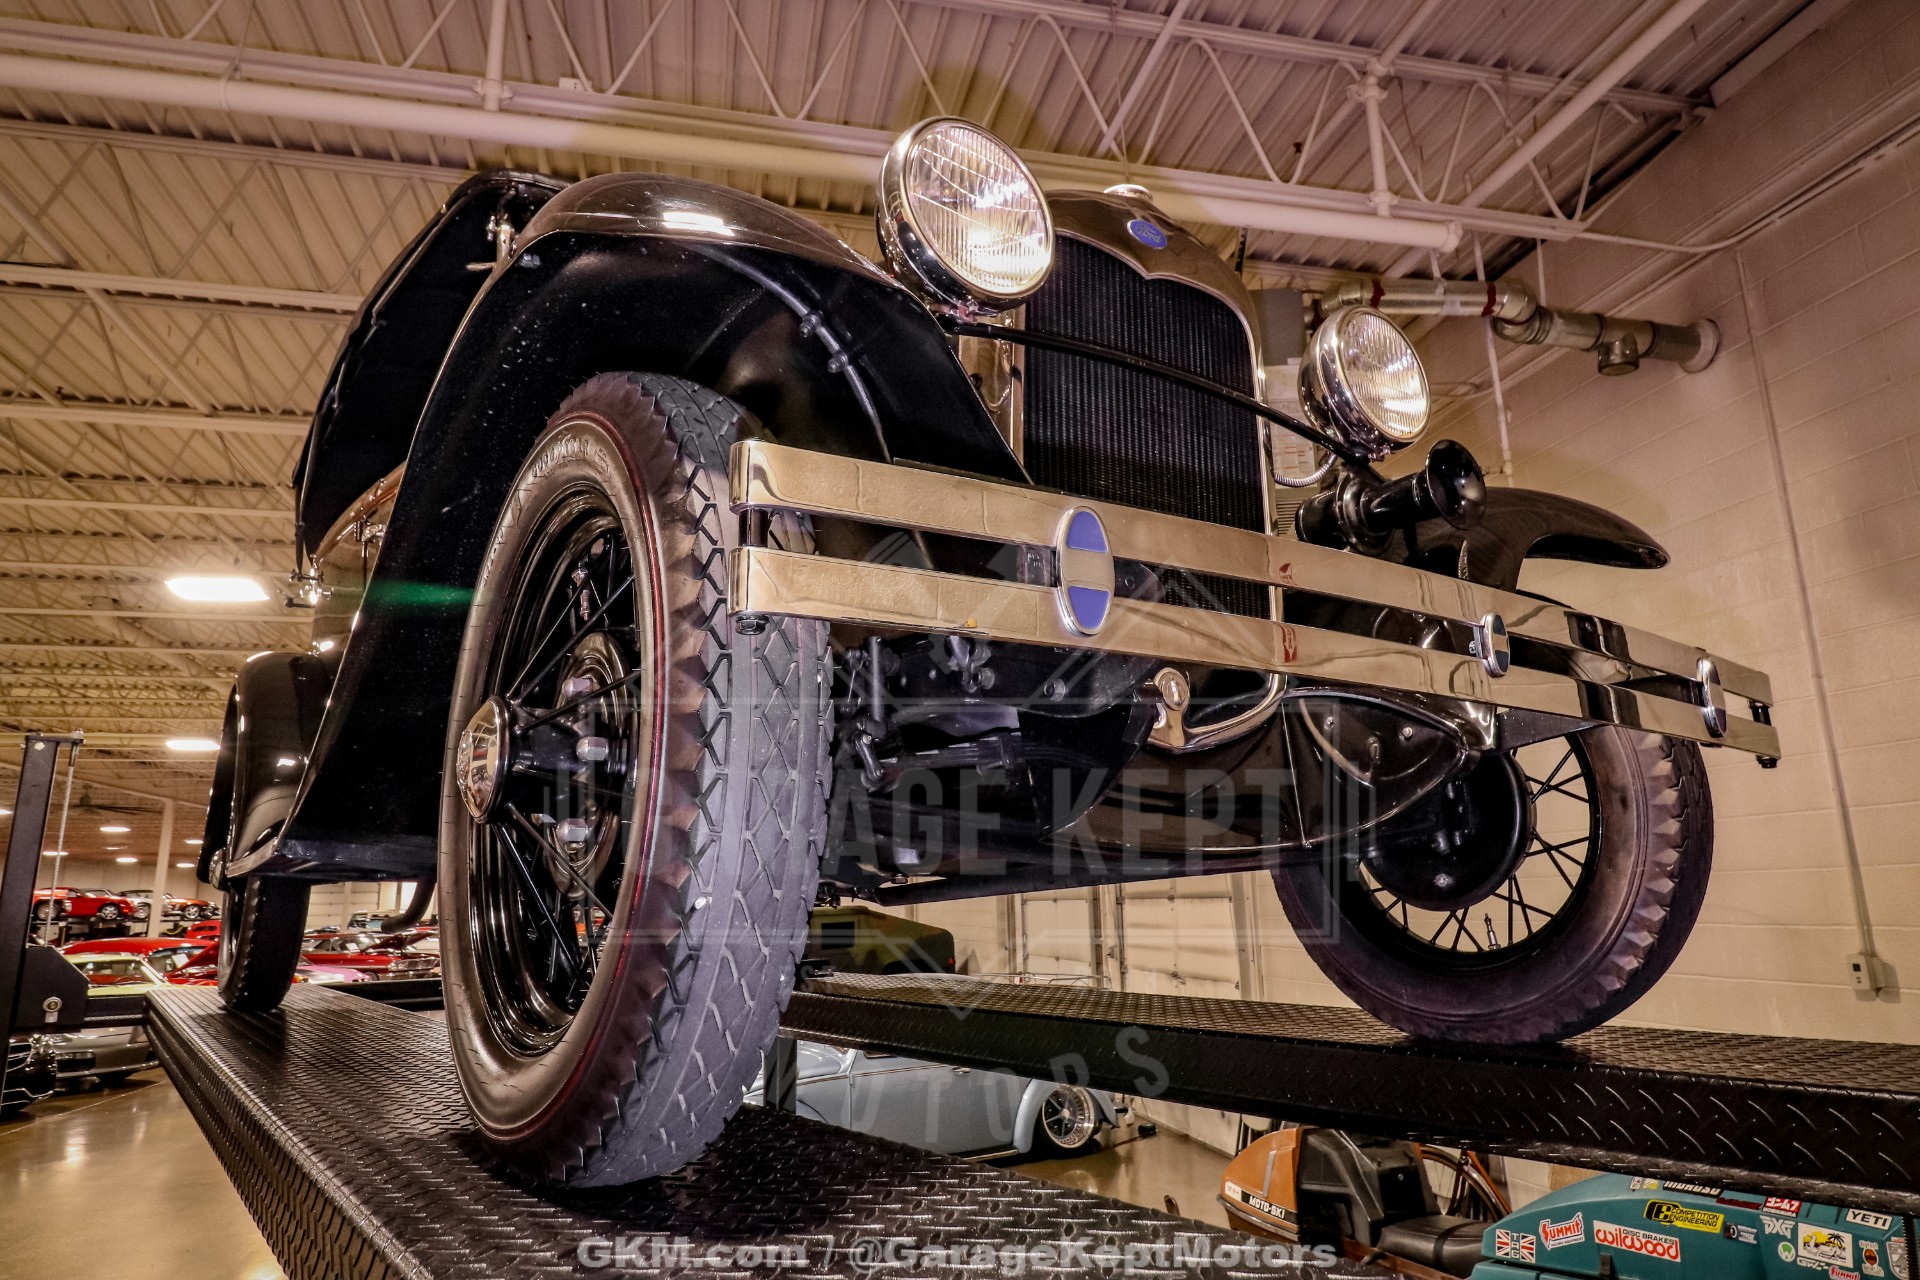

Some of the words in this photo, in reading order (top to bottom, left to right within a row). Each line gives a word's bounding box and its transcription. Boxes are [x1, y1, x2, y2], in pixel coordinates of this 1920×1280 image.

[1136, 223, 1162, 243] Ford
[1249, 1195, 1286, 1219] MOTO-SKI
[1671, 1207, 1719, 1221] COMPETITION
[1669, 1213, 1718, 1228] ENGINEERING
[1851, 1211, 1888, 1228] YETI
[1595, 1225, 1679, 1260] wilwood
[1622, 1229, 1641, 1239] DISC
[1641, 1232, 1675, 1246] BRAKES
